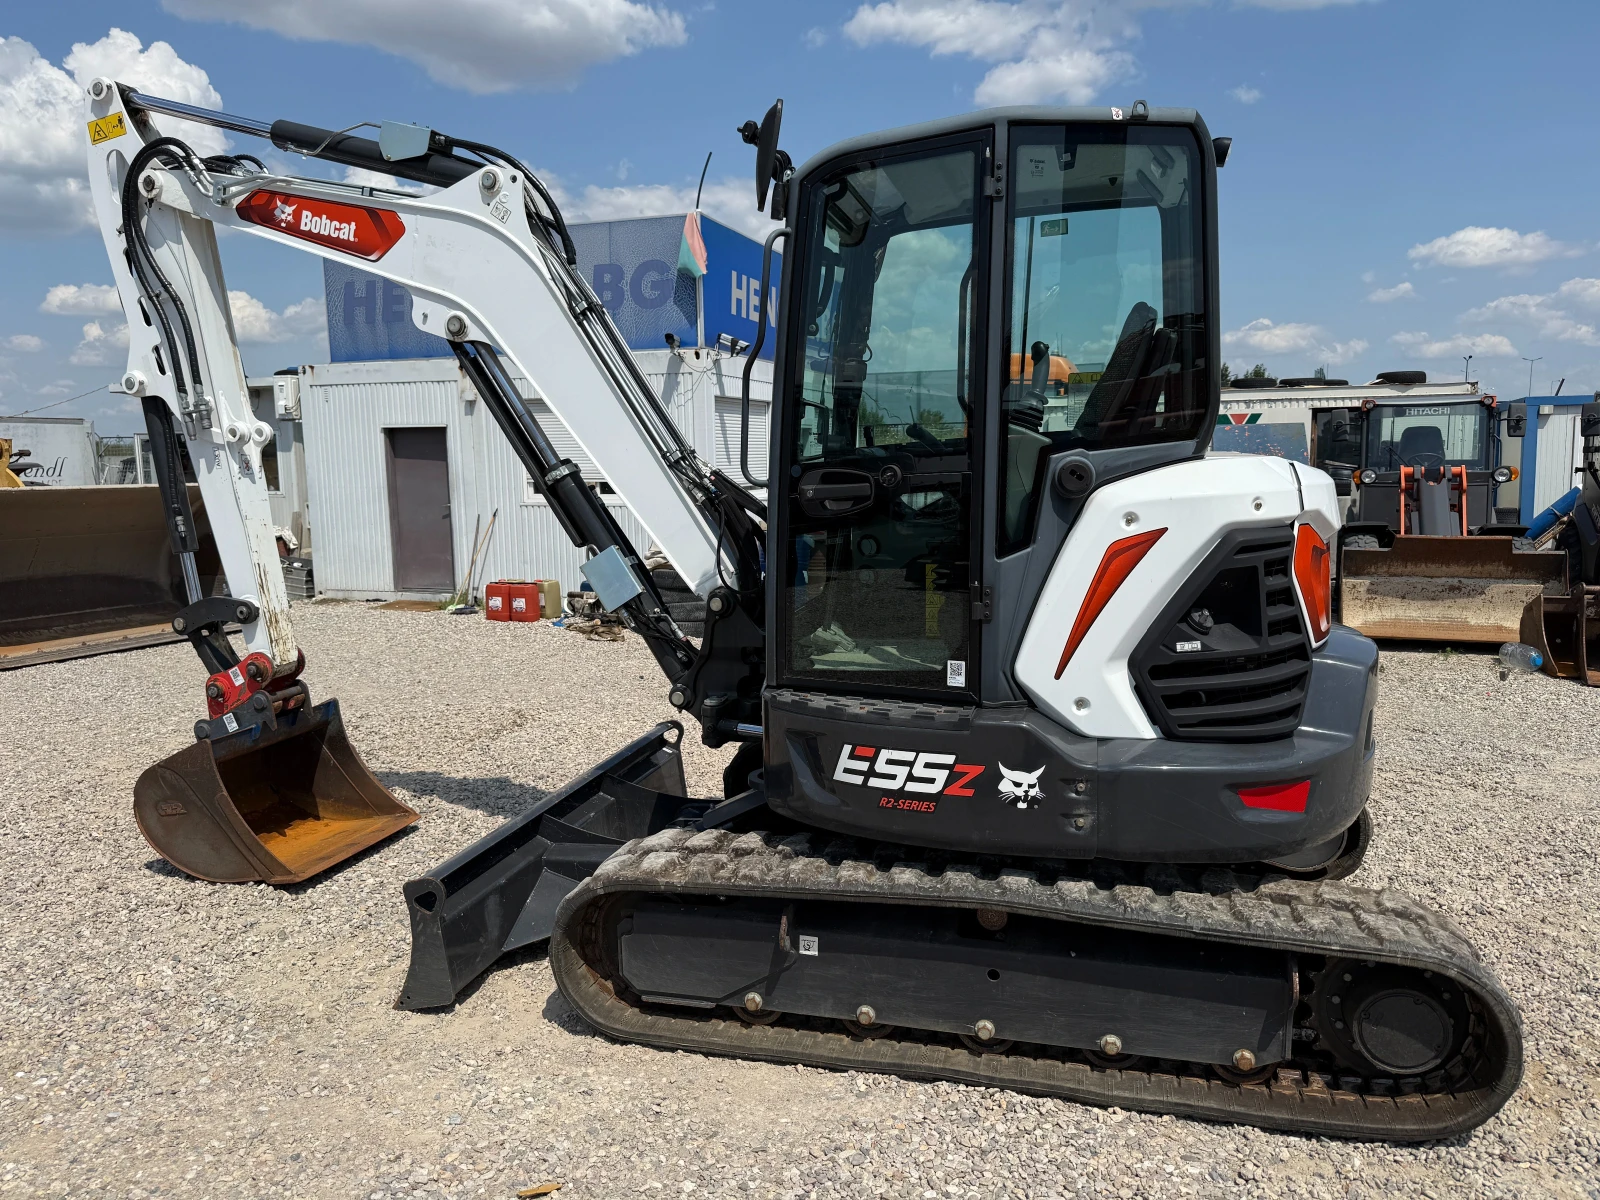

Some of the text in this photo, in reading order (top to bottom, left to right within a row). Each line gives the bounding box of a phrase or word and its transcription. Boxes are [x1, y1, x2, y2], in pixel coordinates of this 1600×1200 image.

[300, 210, 357, 242] Bobcat
[343, 280, 405, 324] HE
[731, 270, 778, 328] HEN
[1405, 407, 1451, 416] HITACHI
[23, 456, 69, 478] endl
[879, 797, 936, 812] R2-SERIES
